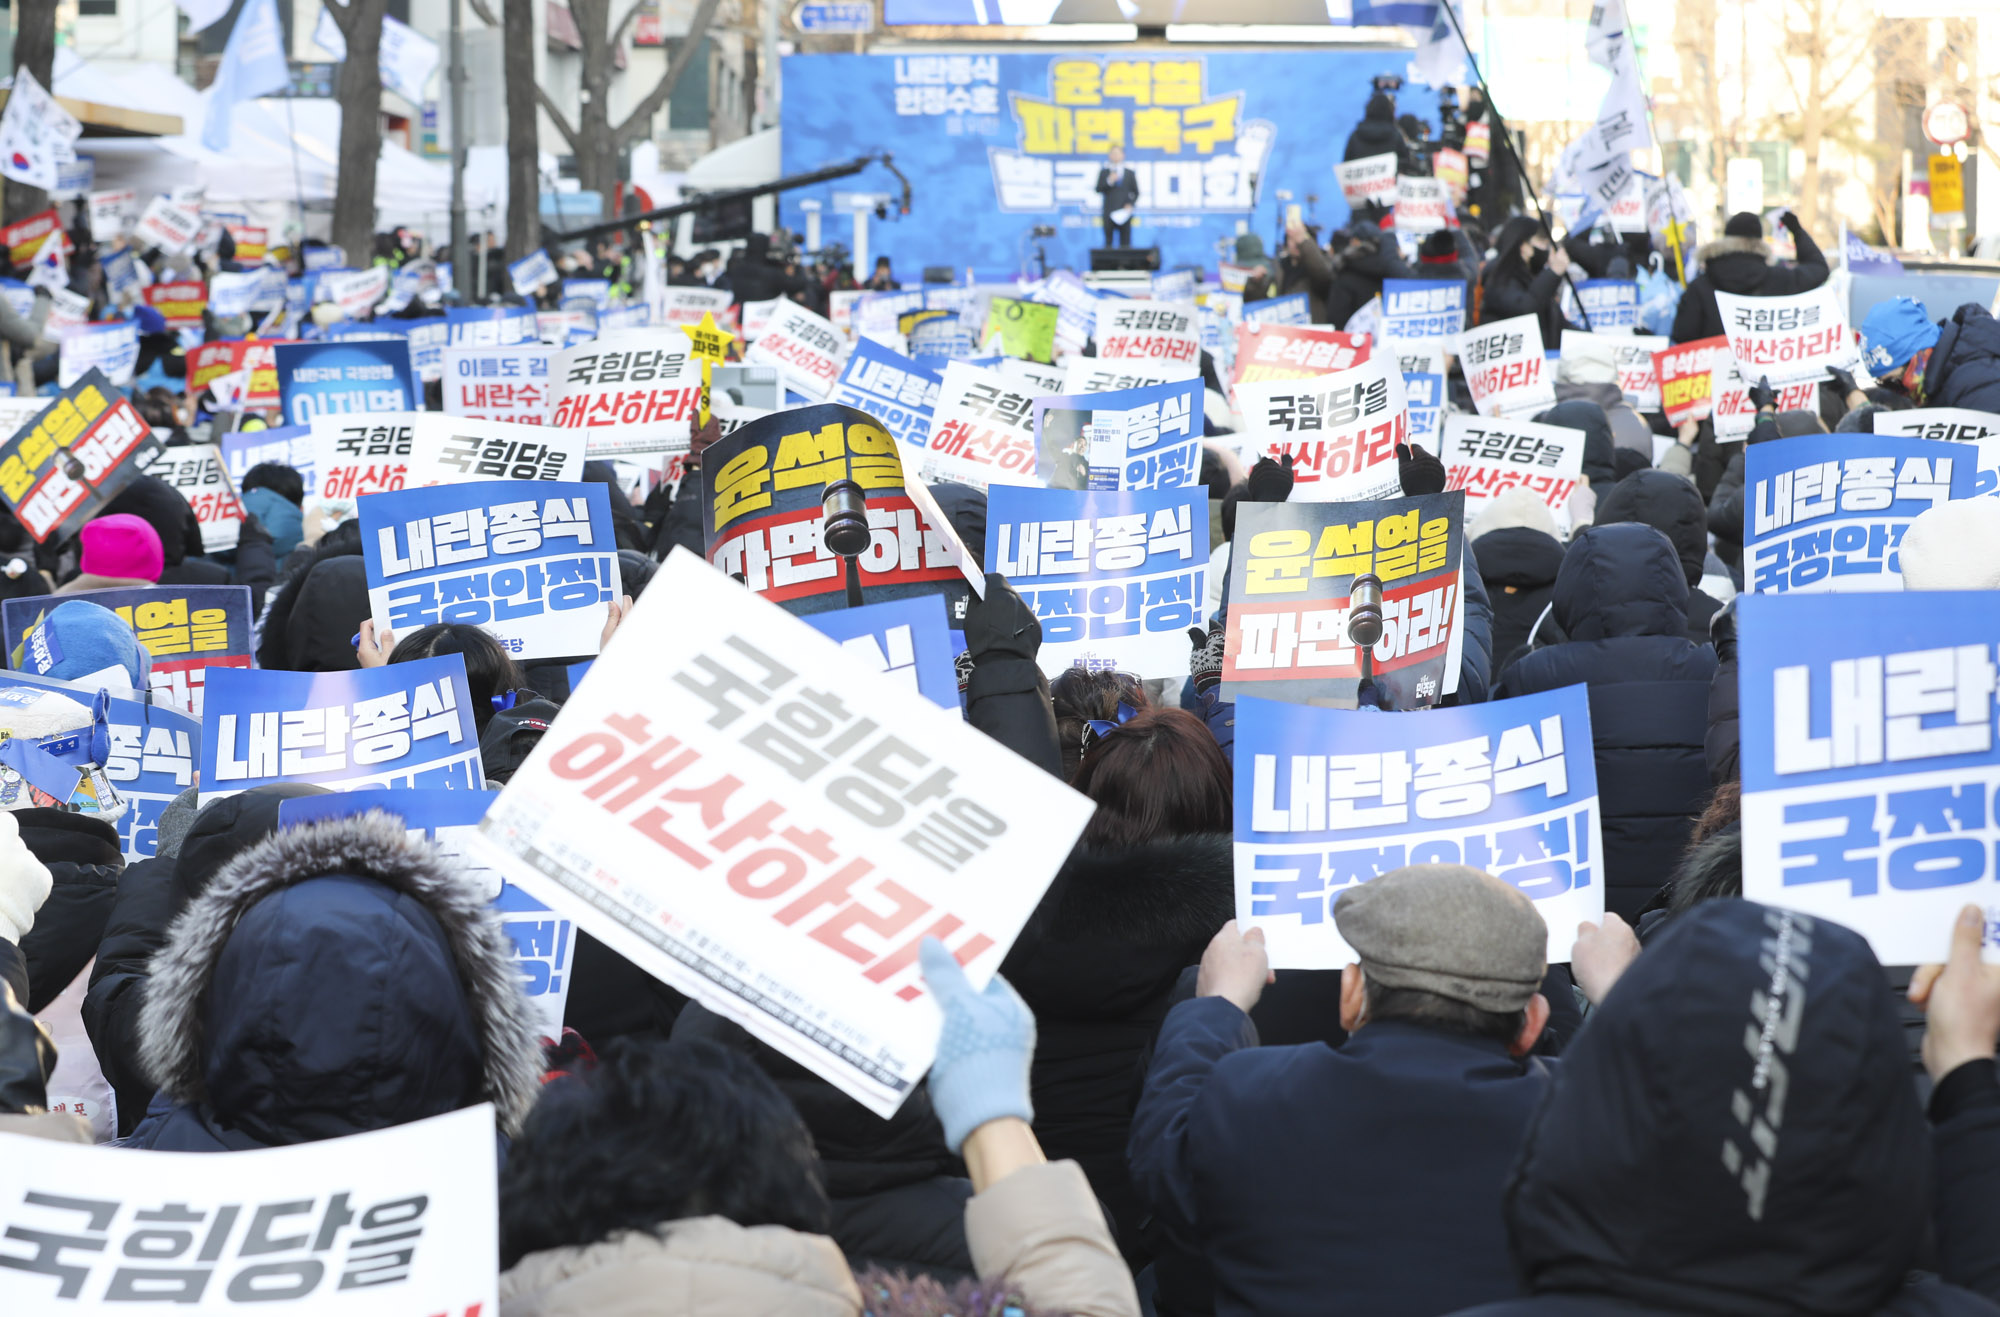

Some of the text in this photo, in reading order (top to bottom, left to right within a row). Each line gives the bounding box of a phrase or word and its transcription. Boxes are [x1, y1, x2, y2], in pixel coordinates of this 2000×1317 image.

[1053, 61, 1202, 105] 윤석열
[1016, 97, 1240, 154] 파면 촉구
[996, 123, 1266, 209] 범국대회
[1102, 335, 1198, 364] 해산하라!
[1112, 308, 1190, 333] 국힘당을
[1733, 306, 1821, 332] 국힘당을
[1735, 324, 1843, 364] 해산하라!
[462, 383, 550, 408] 내란수
[567, 350, 686, 386] 국힘당을
[552, 387, 702, 429] 해산하라!
[1268, 377, 1388, 433] 국힘당을
[438, 434, 567, 482] 국힘당을
[931, 419, 1038, 478] 해산하
[1458, 429, 1564, 468] 국힘당을
[1755, 456, 1954, 537] 내란종식
[378, 497, 594, 578] 내란종식
[996, 503, 1193, 578] 내란종식
[1245, 508, 1449, 595] 윤석열을
[388, 557, 615, 630] 국정안정!
[115, 598, 229, 657] 열을
[1234, 584, 1456, 670] 파면하라!
[215, 675, 464, 781] 내란종식
[1773, 643, 2000, 776] 내란
[671, 634, 1008, 874] 국힘당을
[1251, 713, 1569, 833] 내란종식
[547, 711, 997, 1003] 해산하라!
[1780, 781, 2000, 898] 국정
[0, 1190, 430, 1303] 국힘당을
